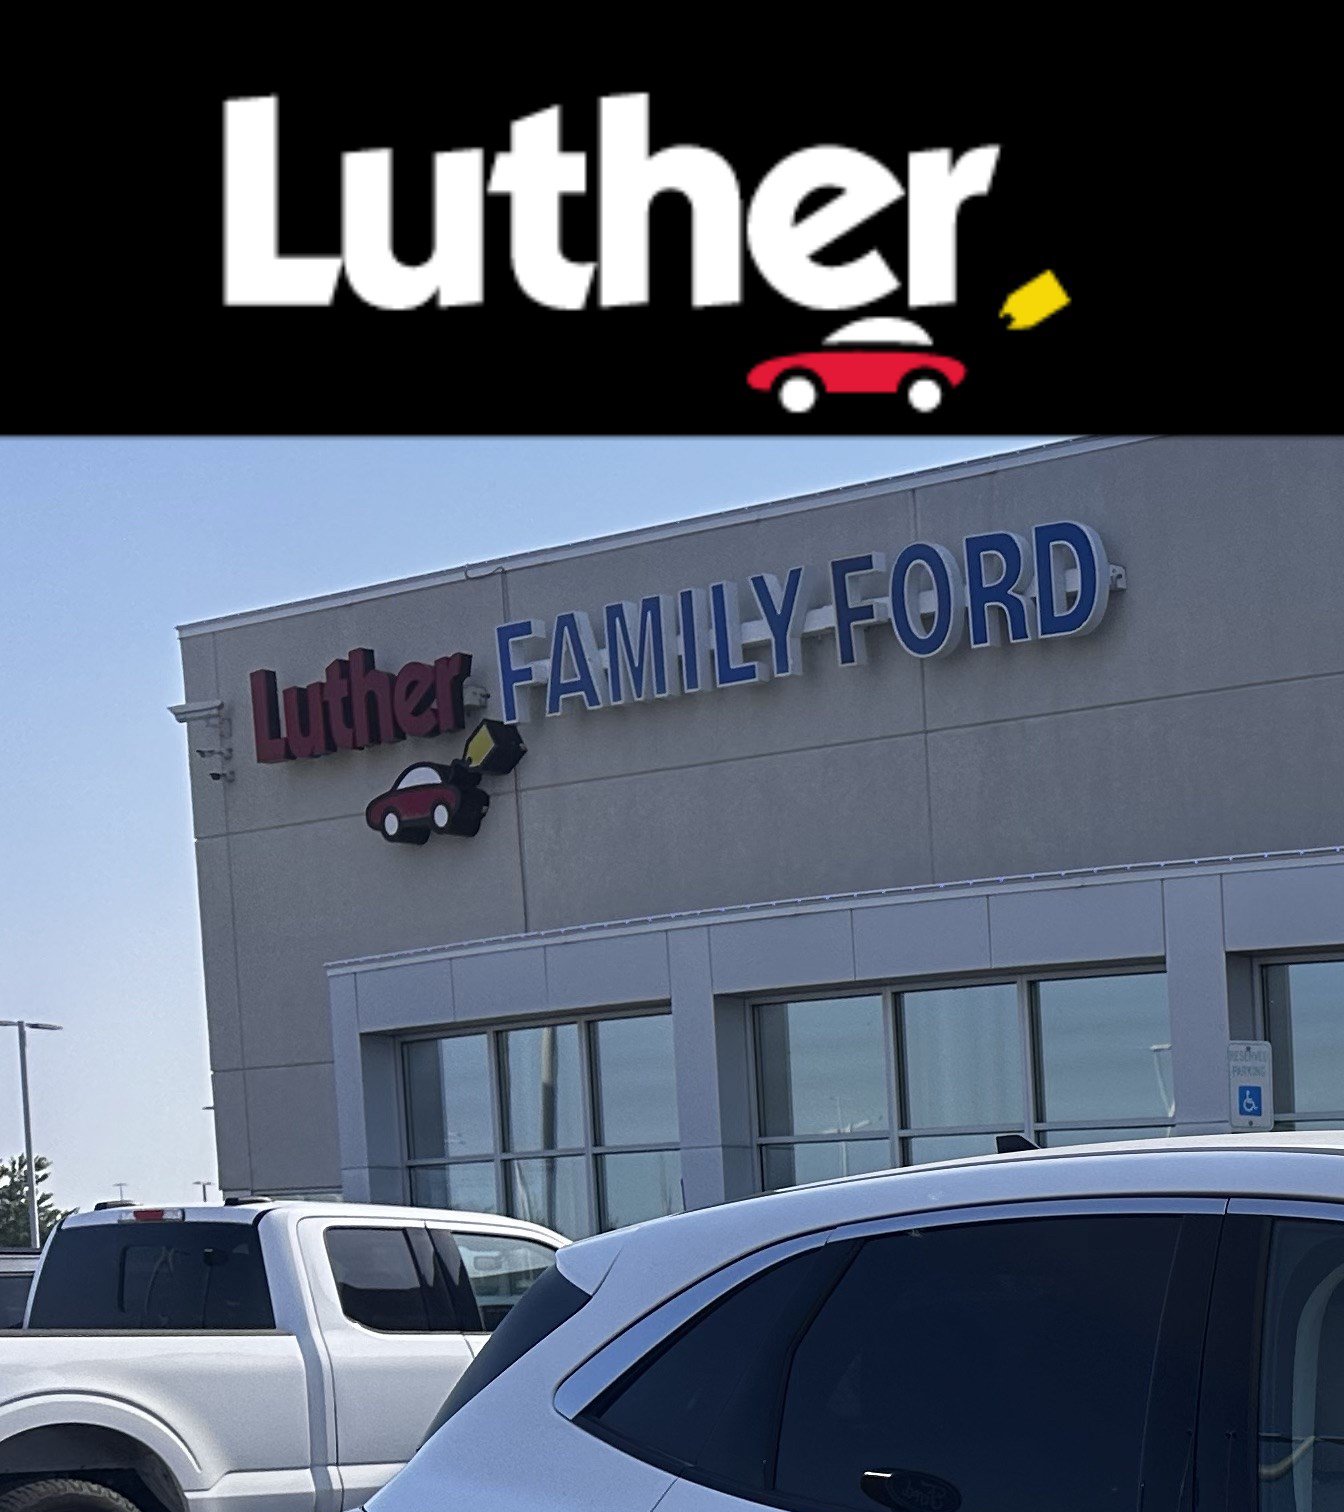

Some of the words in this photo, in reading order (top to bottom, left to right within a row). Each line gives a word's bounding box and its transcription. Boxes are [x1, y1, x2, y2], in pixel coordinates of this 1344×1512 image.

[494, 564, 803, 726] FAMILY
[829, 519, 1110, 668] FORD
[249, 646, 474, 764] Luther
